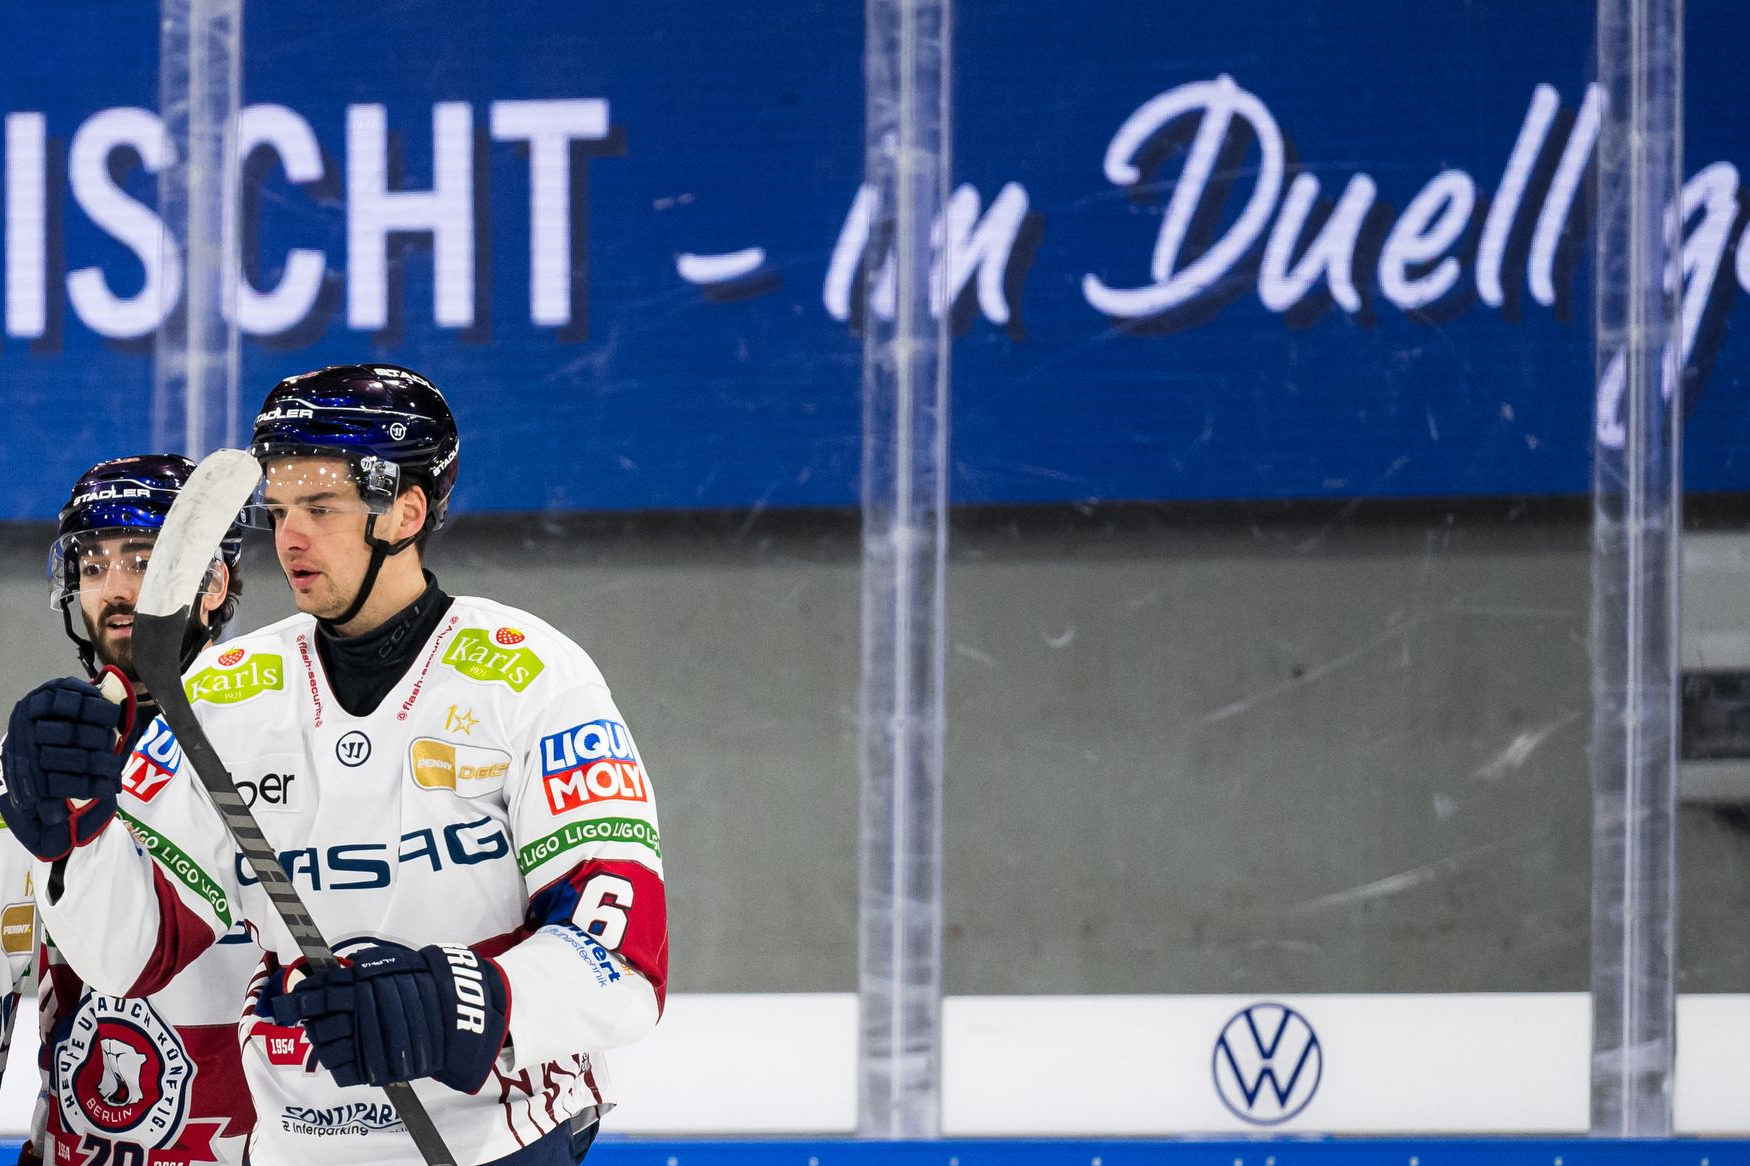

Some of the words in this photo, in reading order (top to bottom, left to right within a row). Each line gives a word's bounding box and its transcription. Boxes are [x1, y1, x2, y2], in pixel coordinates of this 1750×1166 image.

[1082, 74, 1607, 319] Duell
[1599, 160, 1750, 450] g
[255, 408, 314, 420] TADLER
[73, 484, 150, 506] STADLER
[450, 636, 530, 685] Karls
[191, 662, 279, 702] Karls
[546, 722, 635, 771] LIQUI
[549, 765, 647, 816] MOLY
[161, 847, 200, 884] LIGO
[523, 837, 560, 867] LIGO
[565, 822, 612, 845] LIGO
[571, 871, 635, 951] 6
[270, 1038, 295, 1055] 1954
[86, 1097, 133, 1123] BERLIN
